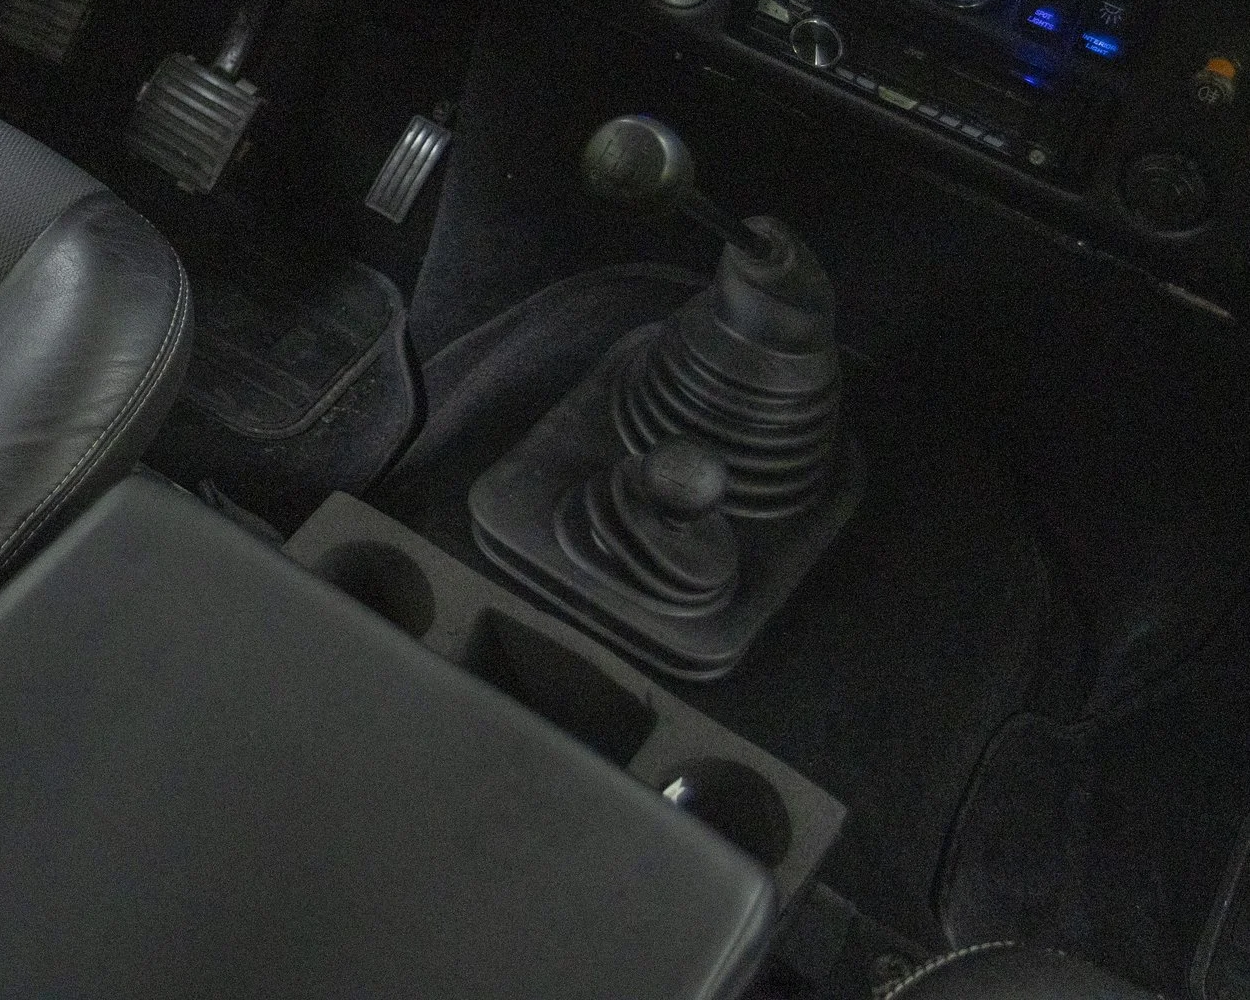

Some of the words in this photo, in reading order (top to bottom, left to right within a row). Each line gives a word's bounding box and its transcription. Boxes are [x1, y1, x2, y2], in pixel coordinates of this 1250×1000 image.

[1034, 9, 1054, 20] SPOT
[1027, 15, 1055, 31] LIGHTS
[1082, 32, 1119, 52] INTERIOR
[1085, 42, 1109, 56] LIGHT
